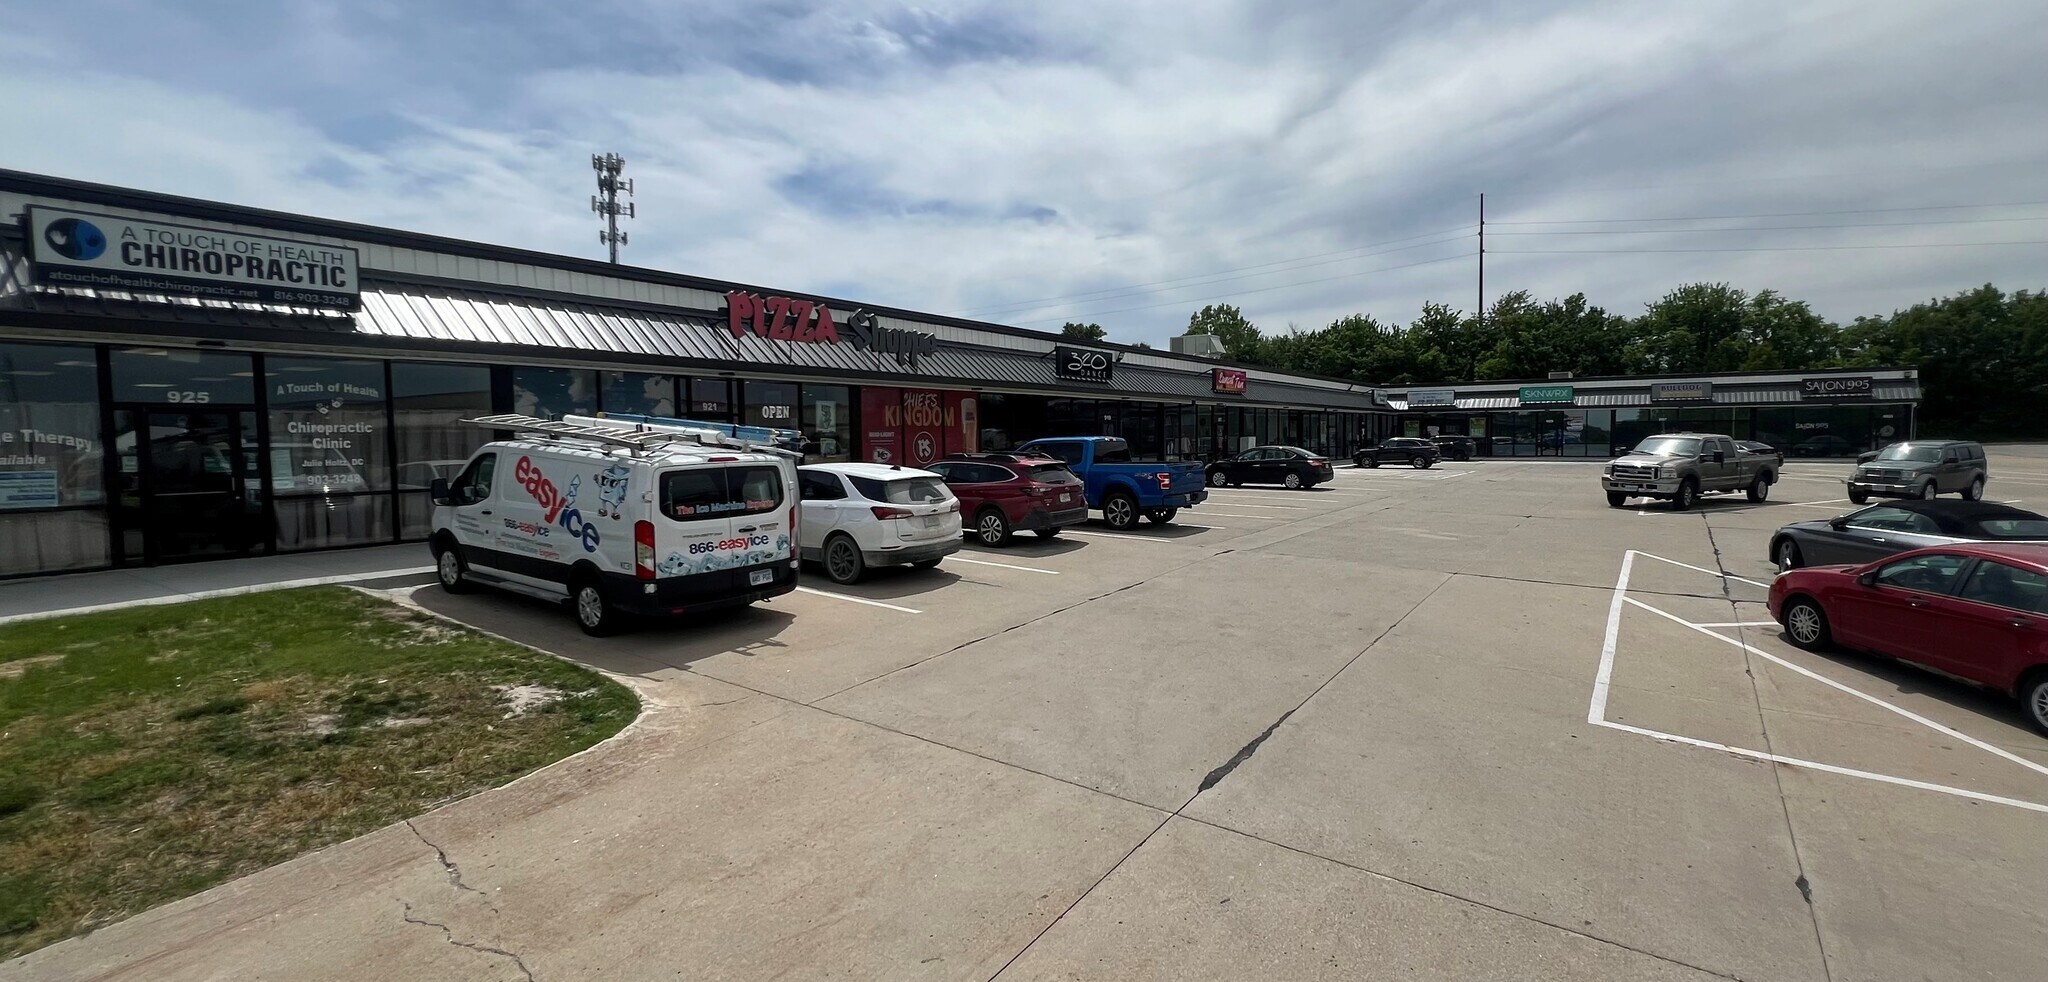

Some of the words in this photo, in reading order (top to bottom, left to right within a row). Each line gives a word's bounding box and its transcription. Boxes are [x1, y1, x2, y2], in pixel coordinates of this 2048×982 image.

[121, 226, 137, 240] A
[144, 228, 226, 251] TOUCH
[233, 240, 262, 255] OF
[268, 244, 344, 266] HEALTH
[121, 241, 347, 288] CHIROPRACTIC
[49, 271, 259, 298] atouchofhealthchiropractic.net
[273, 290, 350, 306] 816-903-3248
[727, 290, 842, 345] PIZZA
[848, 308, 938, 368] Shoppe
[1067, 352, 1107, 370] 320
[277, 385, 285, 396] A
[286, 382, 324, 394] Touch
[327, 382, 340, 393] of
[343, 383, 380, 399] Health
[1847, 379, 1870, 390] 905
[167, 391, 210, 404] 925
[1524, 389, 1568, 398] SKNWRX
[702, 402, 717, 411] 921
[761, 405, 790, 419] OPEN
[885, 405, 955, 427] KINGDOM
[287, 421, 373, 436] Chiropractic
[20, 428, 93, 453] Therapy
[312, 437, 352, 449] Clinic
[351, 458, 364, 466] DC
[307, 474, 361, 486] 903-3248
[676, 505, 695, 515] The
[689, 533, 769, 554] 866-easyice
